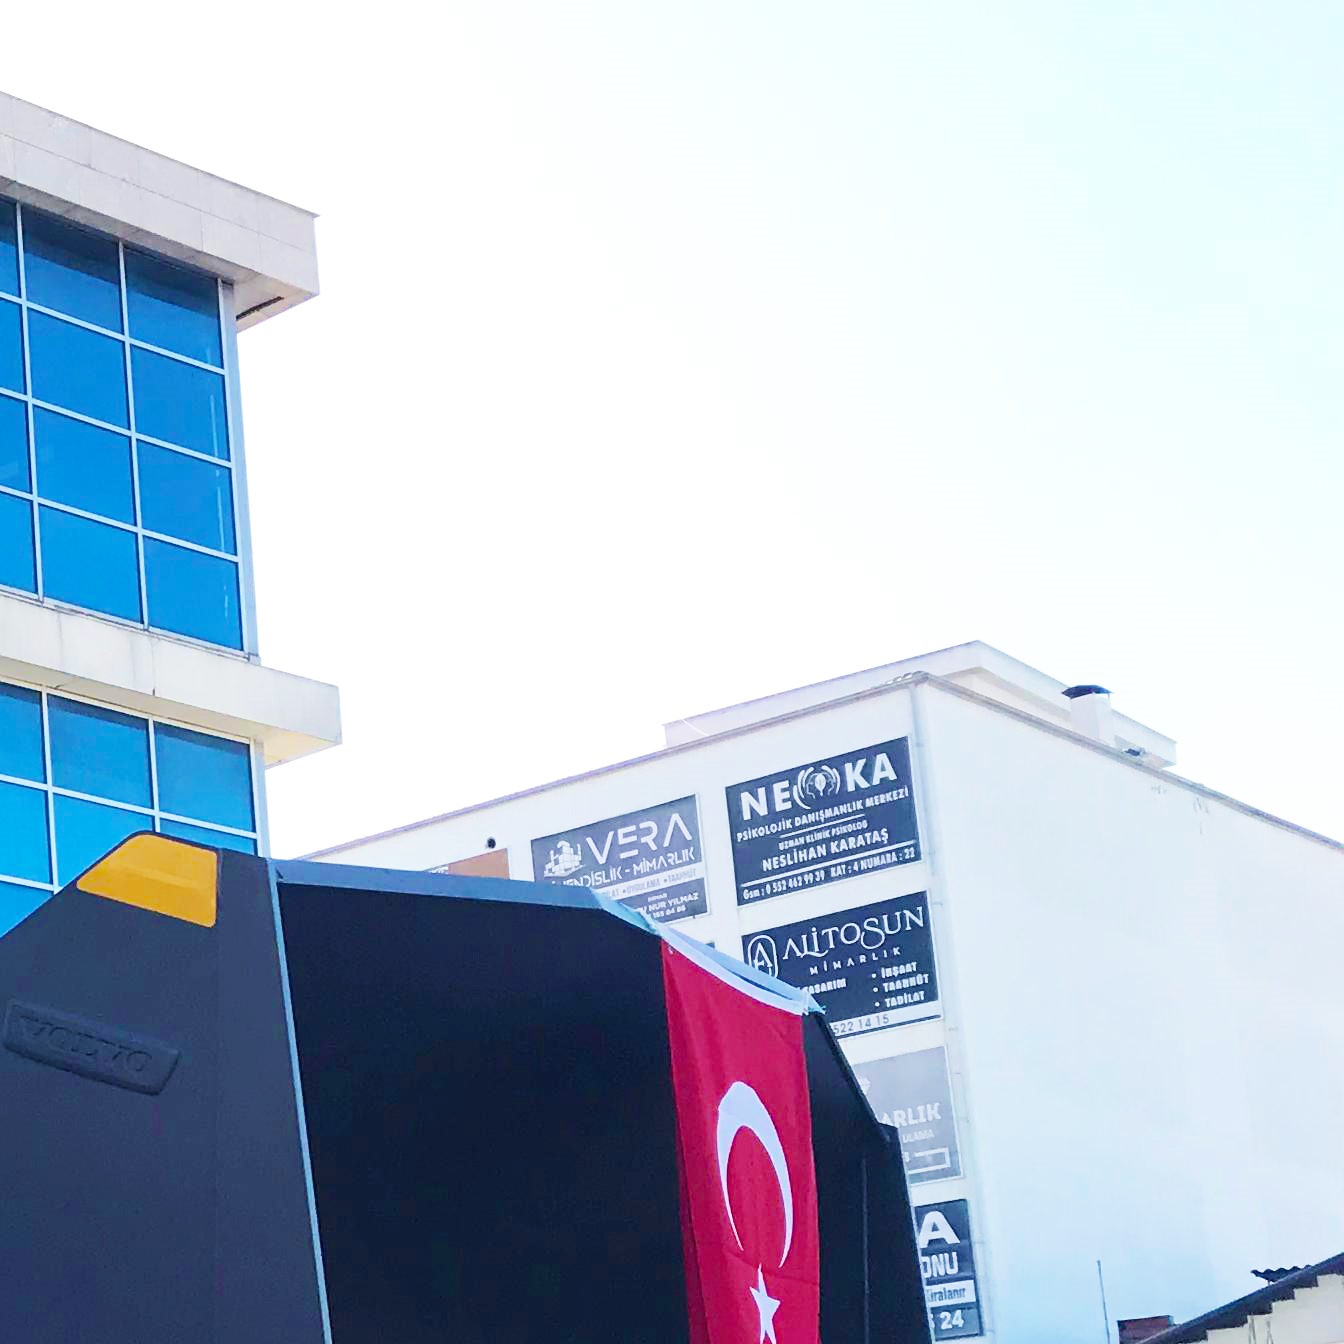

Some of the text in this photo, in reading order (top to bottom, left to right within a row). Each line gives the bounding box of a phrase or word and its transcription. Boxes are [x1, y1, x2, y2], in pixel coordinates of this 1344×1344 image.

[737, 786, 909, 843] PSİKOLOJİK DANIŞMANLIK MERKEZİ
[585, 812, 693, 865] VERA
[762, 828, 889, 872] NESLİHAN KARATAŞ
[633, 846, 696, 876] MİMARLIK
[830, 864, 847, 879] KAT
[860, 851, 898, 871] NUMARA
[668, 892, 700, 907] YILMAZ
[809, 947, 901, 975] MİMARLIK
[859, 1018, 871, 1030] 14
[877, 1015, 889, 1026] 15
[939, 1310, 965, 1330] 24
